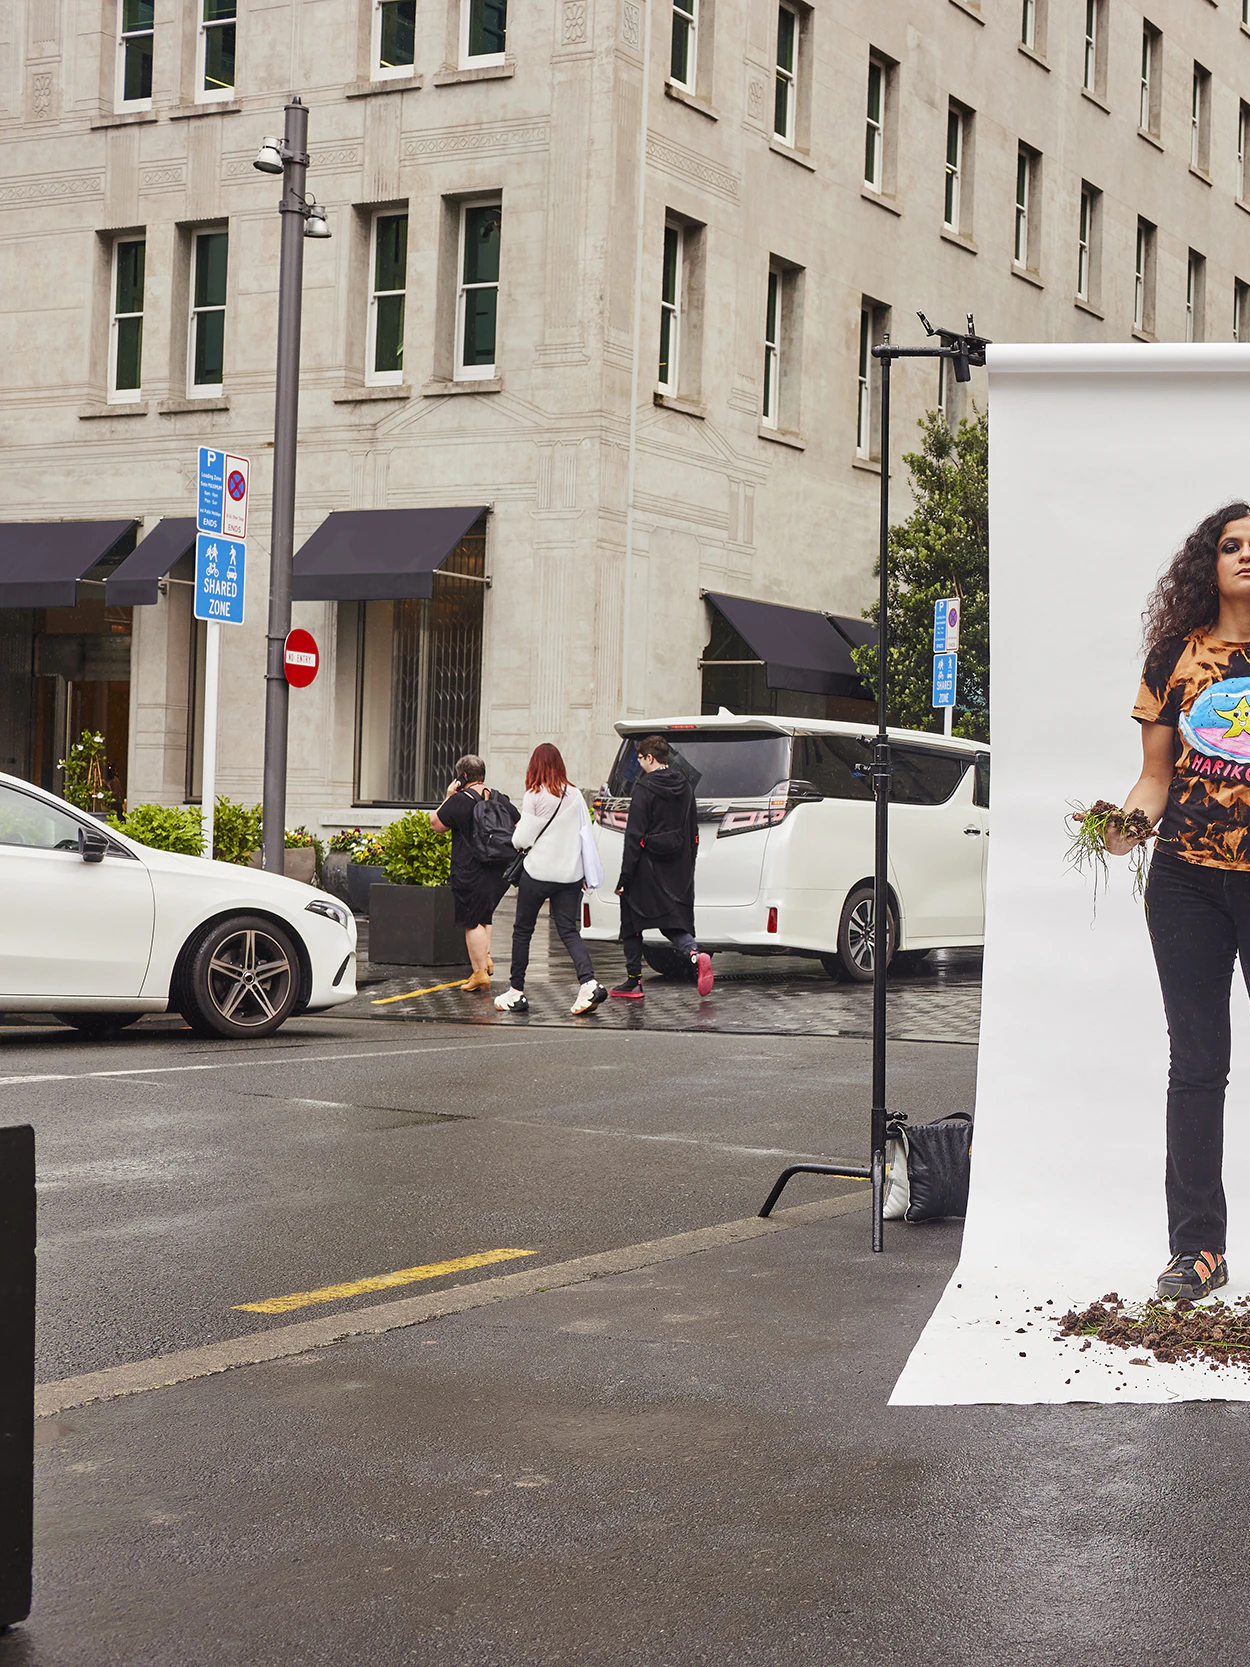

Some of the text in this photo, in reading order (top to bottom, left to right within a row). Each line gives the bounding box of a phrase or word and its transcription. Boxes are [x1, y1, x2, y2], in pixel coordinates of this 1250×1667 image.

[207, 451, 216, 467] P
[202, 517, 218, 528] ENDS
[227, 523, 242, 534] ENDS
[203, 577, 238, 598] SHARED
[208, 598, 231, 617] ZONE
[288, 653, 312, 664] NO ENTRY
[936, 680, 953, 690] SHARED
[938, 693, 949, 703] ZONE
